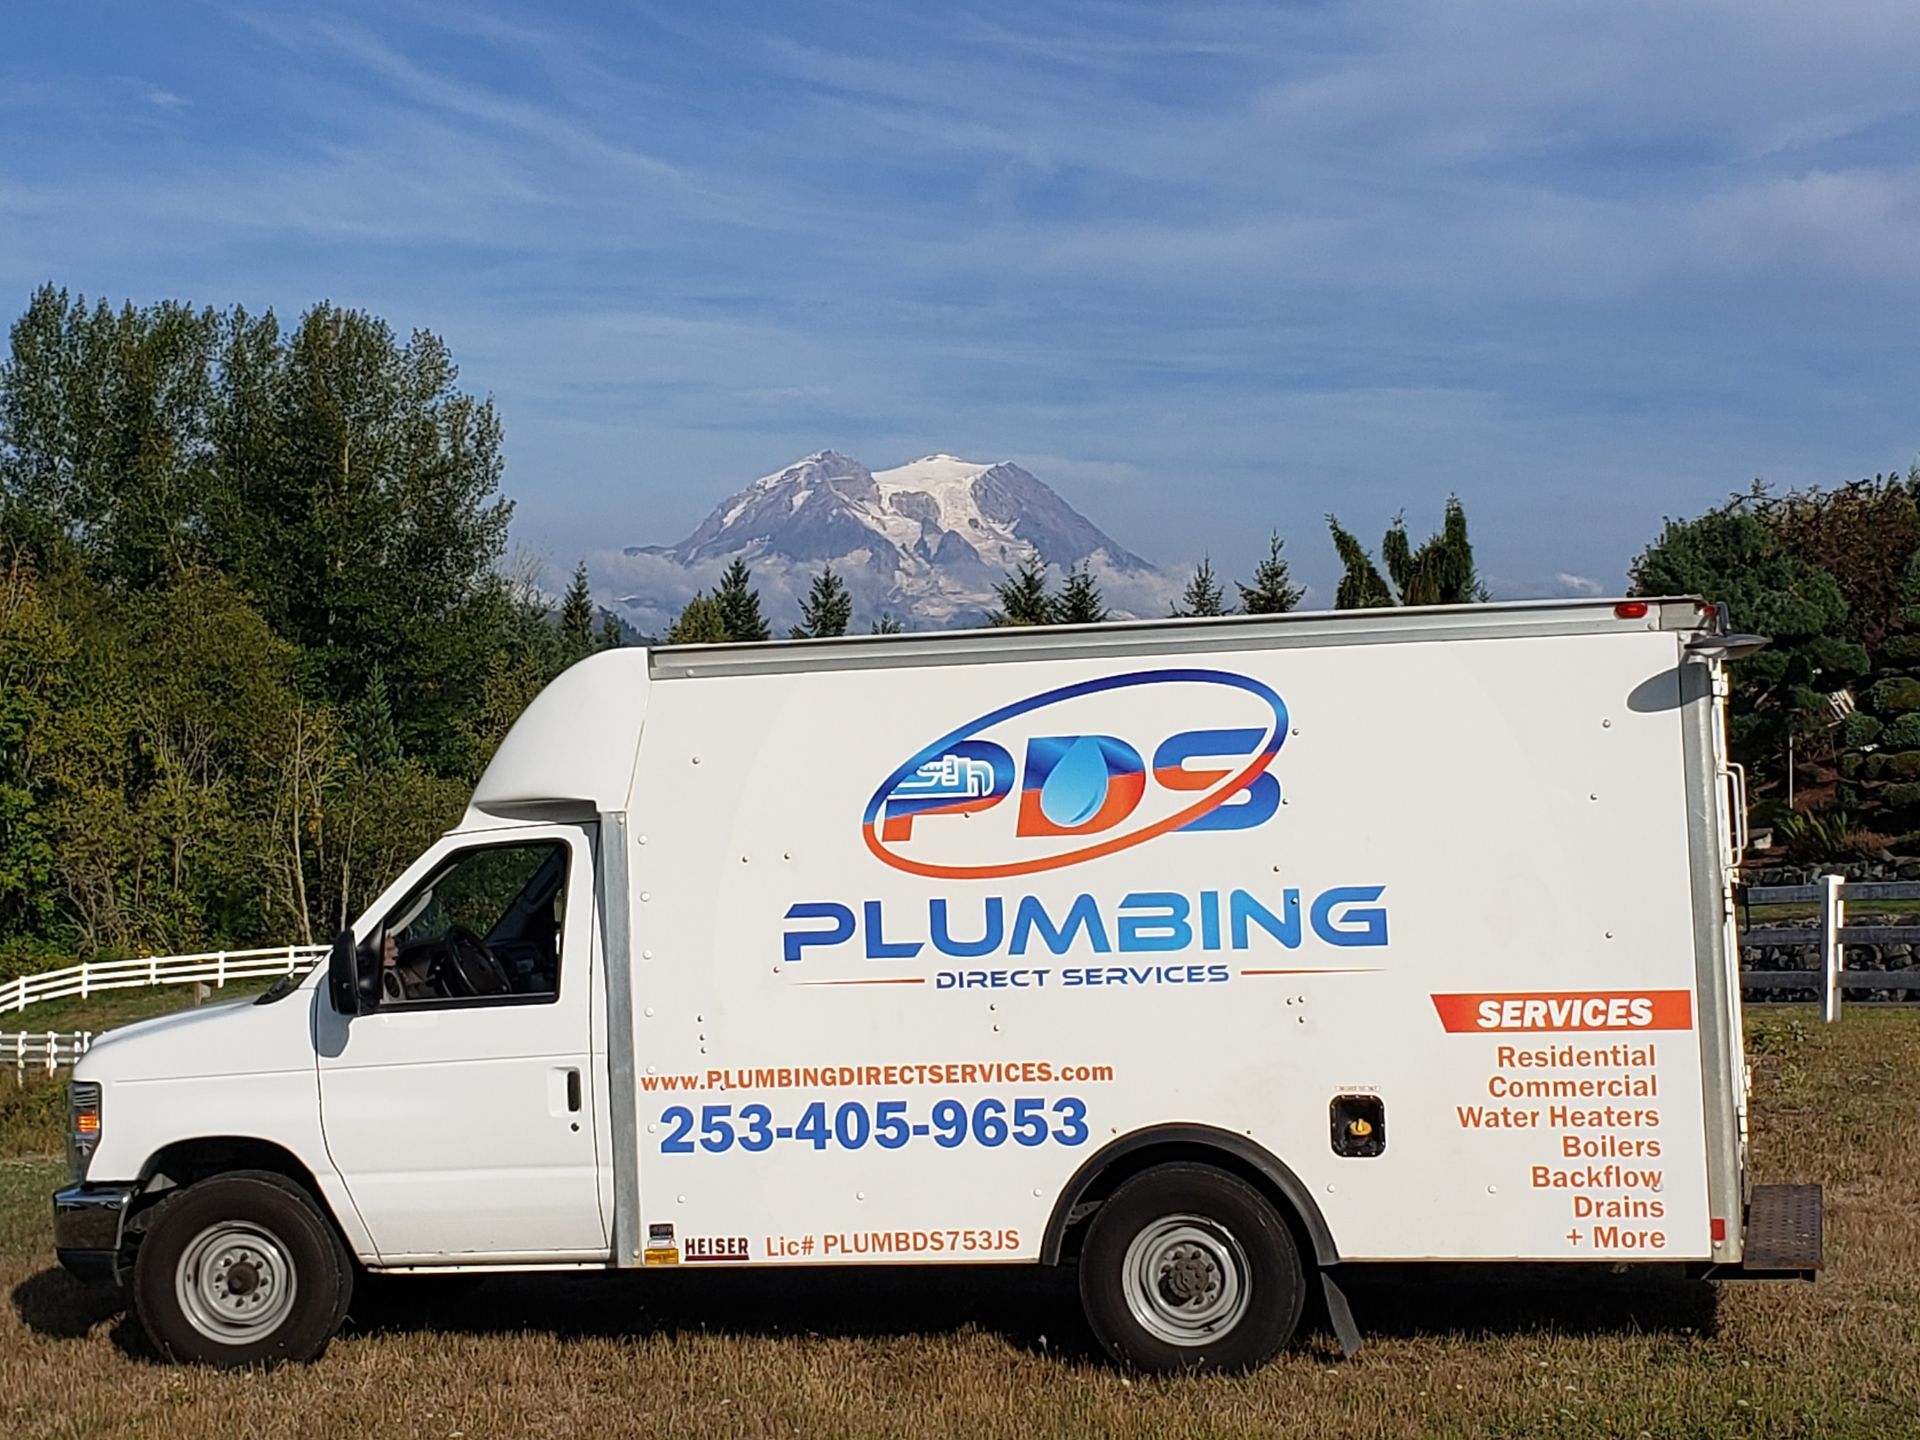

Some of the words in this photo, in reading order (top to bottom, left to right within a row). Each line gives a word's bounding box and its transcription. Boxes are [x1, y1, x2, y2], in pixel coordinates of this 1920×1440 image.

[881, 726, 1281, 841] PDS
[783, 885, 1389, 961] PLUMBING
[936, 969, 1050, 989] DIRECT
[1062, 964, 1229, 987] SERVICES
[1476, 998, 1653, 1028] SERVICES
[1497, 1044, 1656, 1069] Residential
[641, 1062, 1114, 1091] www.PLUMBINGDIRECTSERVICES.com
[1488, 1075, 1657, 1098] Commercial
[660, 1097, 1089, 1154] 253-405-9653
[1456, 1106, 1540, 1129] Water
[1549, 1105, 1660, 1128] Heaters
[1562, 1135, 1661, 1158] Boilers
[1531, 1165, 1662, 1188] Backflow
[1573, 1196, 1665, 1218] Drains
[685, 1238, 749, 1254] HEISER
[766, 1236, 815, 1257] Lic#
[823, 1230, 1020, 1255] PLUMBDS753JS
[1593, 1226, 1666, 1249] More
